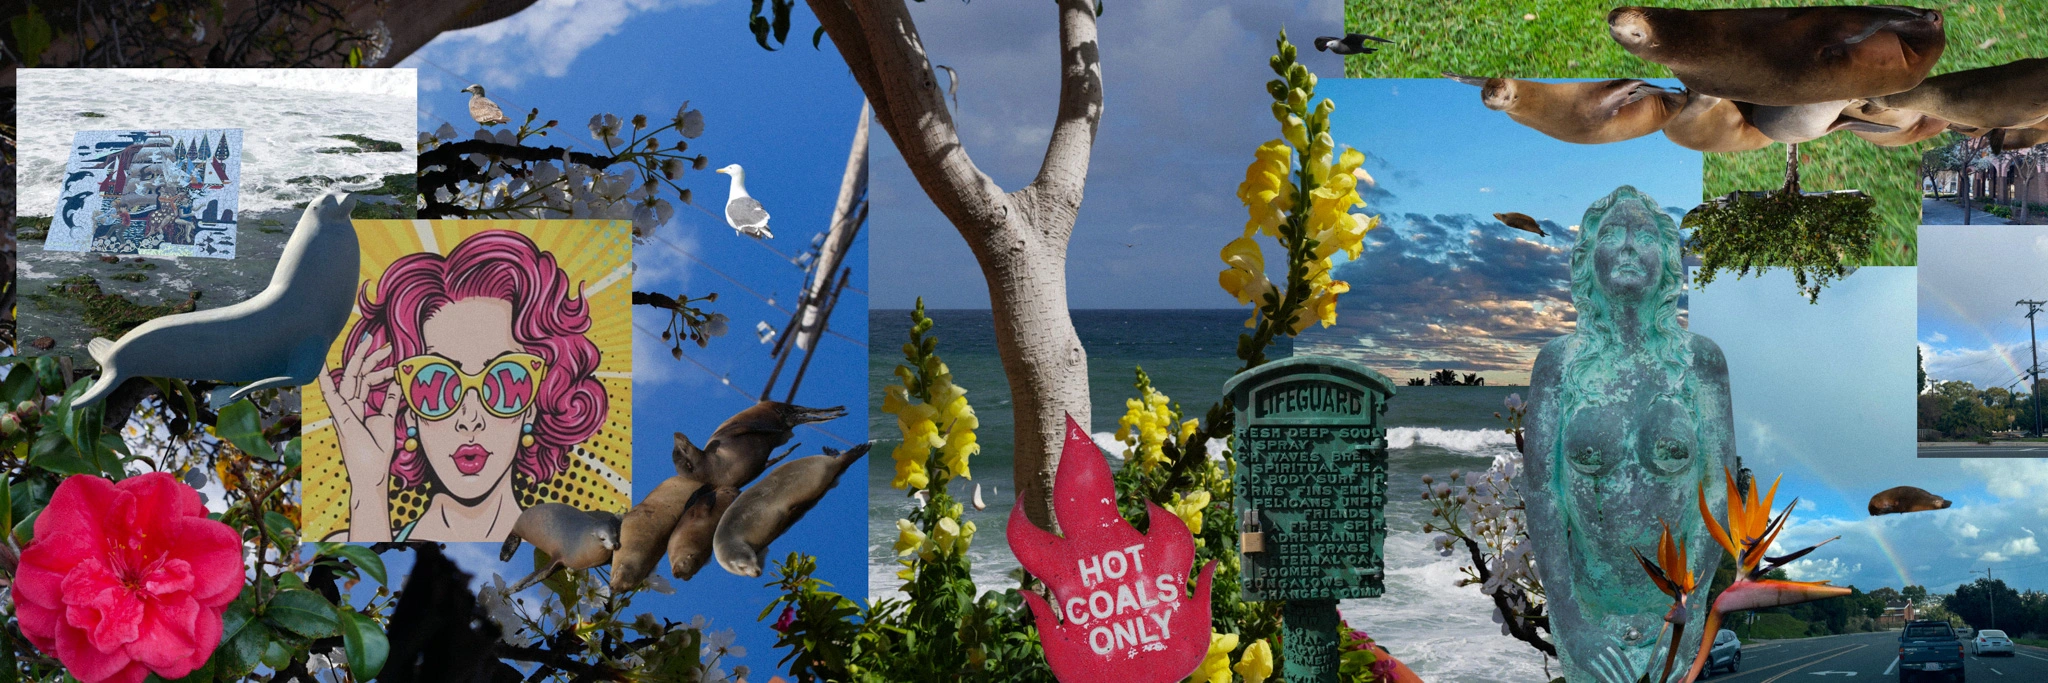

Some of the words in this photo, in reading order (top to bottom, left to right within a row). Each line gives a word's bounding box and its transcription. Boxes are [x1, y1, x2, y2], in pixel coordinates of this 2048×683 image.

[1256, 384, 1362, 418] LIFEGUARD
[1288, 428, 1330, 438] DEEP
[1340, 428, 1381, 438] SOUL
[1256, 440, 1309, 450] SPRAY
[1268, 452, 1321, 462] WAVES
[1253, 463, 1338, 473] SPIRITUAL
[1269, 474, 1308, 484] BODY
[1316, 474, 1357, 484] SURF
[1297, 486, 1333, 495] FINS
[1254, 498, 1331, 508] PELICANS
[1303, 509, 1370, 518] FRIENDS
[1290, 521, 1329, 531] FREE
[1280, 544, 1308, 554] EEL
[1316, 543, 1370, 553] GRASS
[1078, 543, 1145, 587] HOT
[1259, 567, 1320, 577] BOOMER
[1243, 577, 1344, 588] BUNGALOWS
[1066, 574, 1178, 625] COALS
[1259, 589, 1330, 600] CHANGES
[1089, 609, 1171, 655] ONLY
